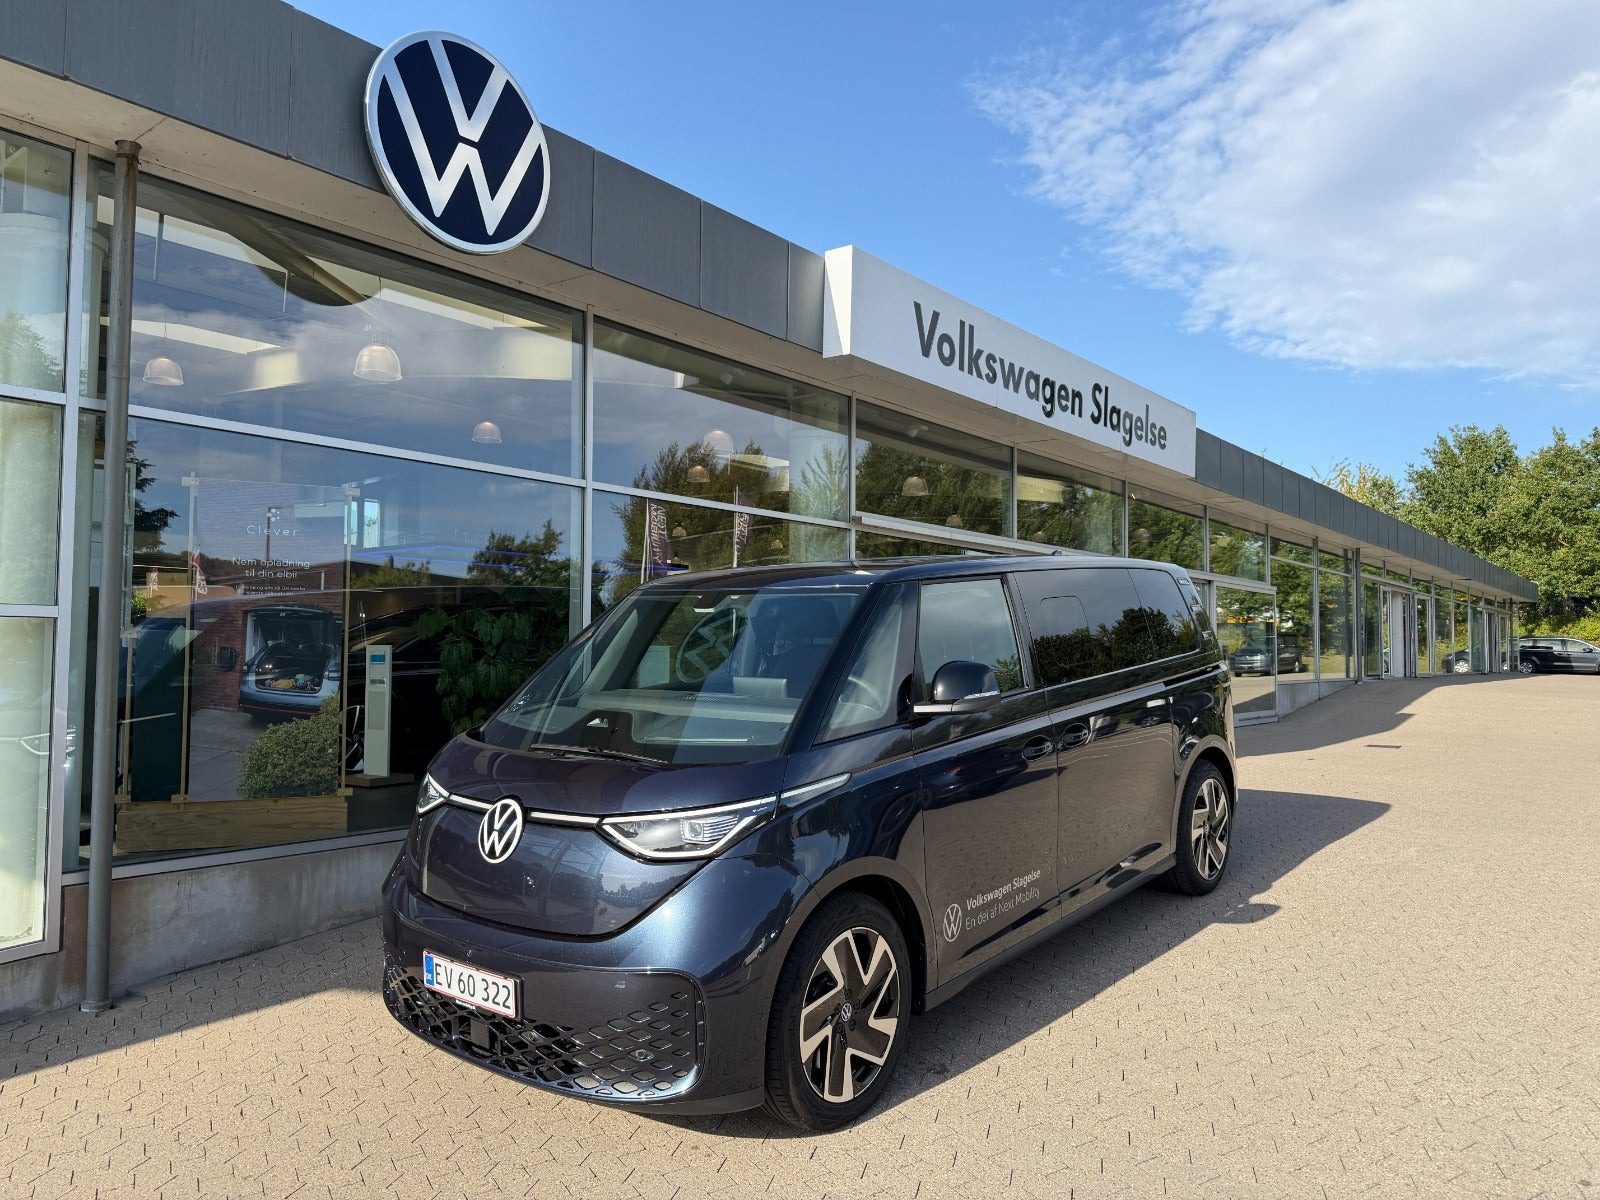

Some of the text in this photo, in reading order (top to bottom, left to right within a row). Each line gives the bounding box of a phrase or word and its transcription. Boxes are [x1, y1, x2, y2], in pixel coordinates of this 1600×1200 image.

[366, 31, 550, 253] VW
[913, 300, 1167, 450] Volkswagen Slagelse
[246, 524, 298, 536] Clever
[232, 556, 310, 569] Nem opladning
[244, 568, 297, 579] til din elbil
[478, 798, 522, 864] VW
[965, 917, 976, 930] En
[990, 904, 998, 919] af
[998, 898, 1015, 913] Next
[1015, 887, 1040, 906] Mobility
[966, 869, 1041, 911] Volkswagen Slagelse
[434, 962, 511, 1010] EV 60 322
